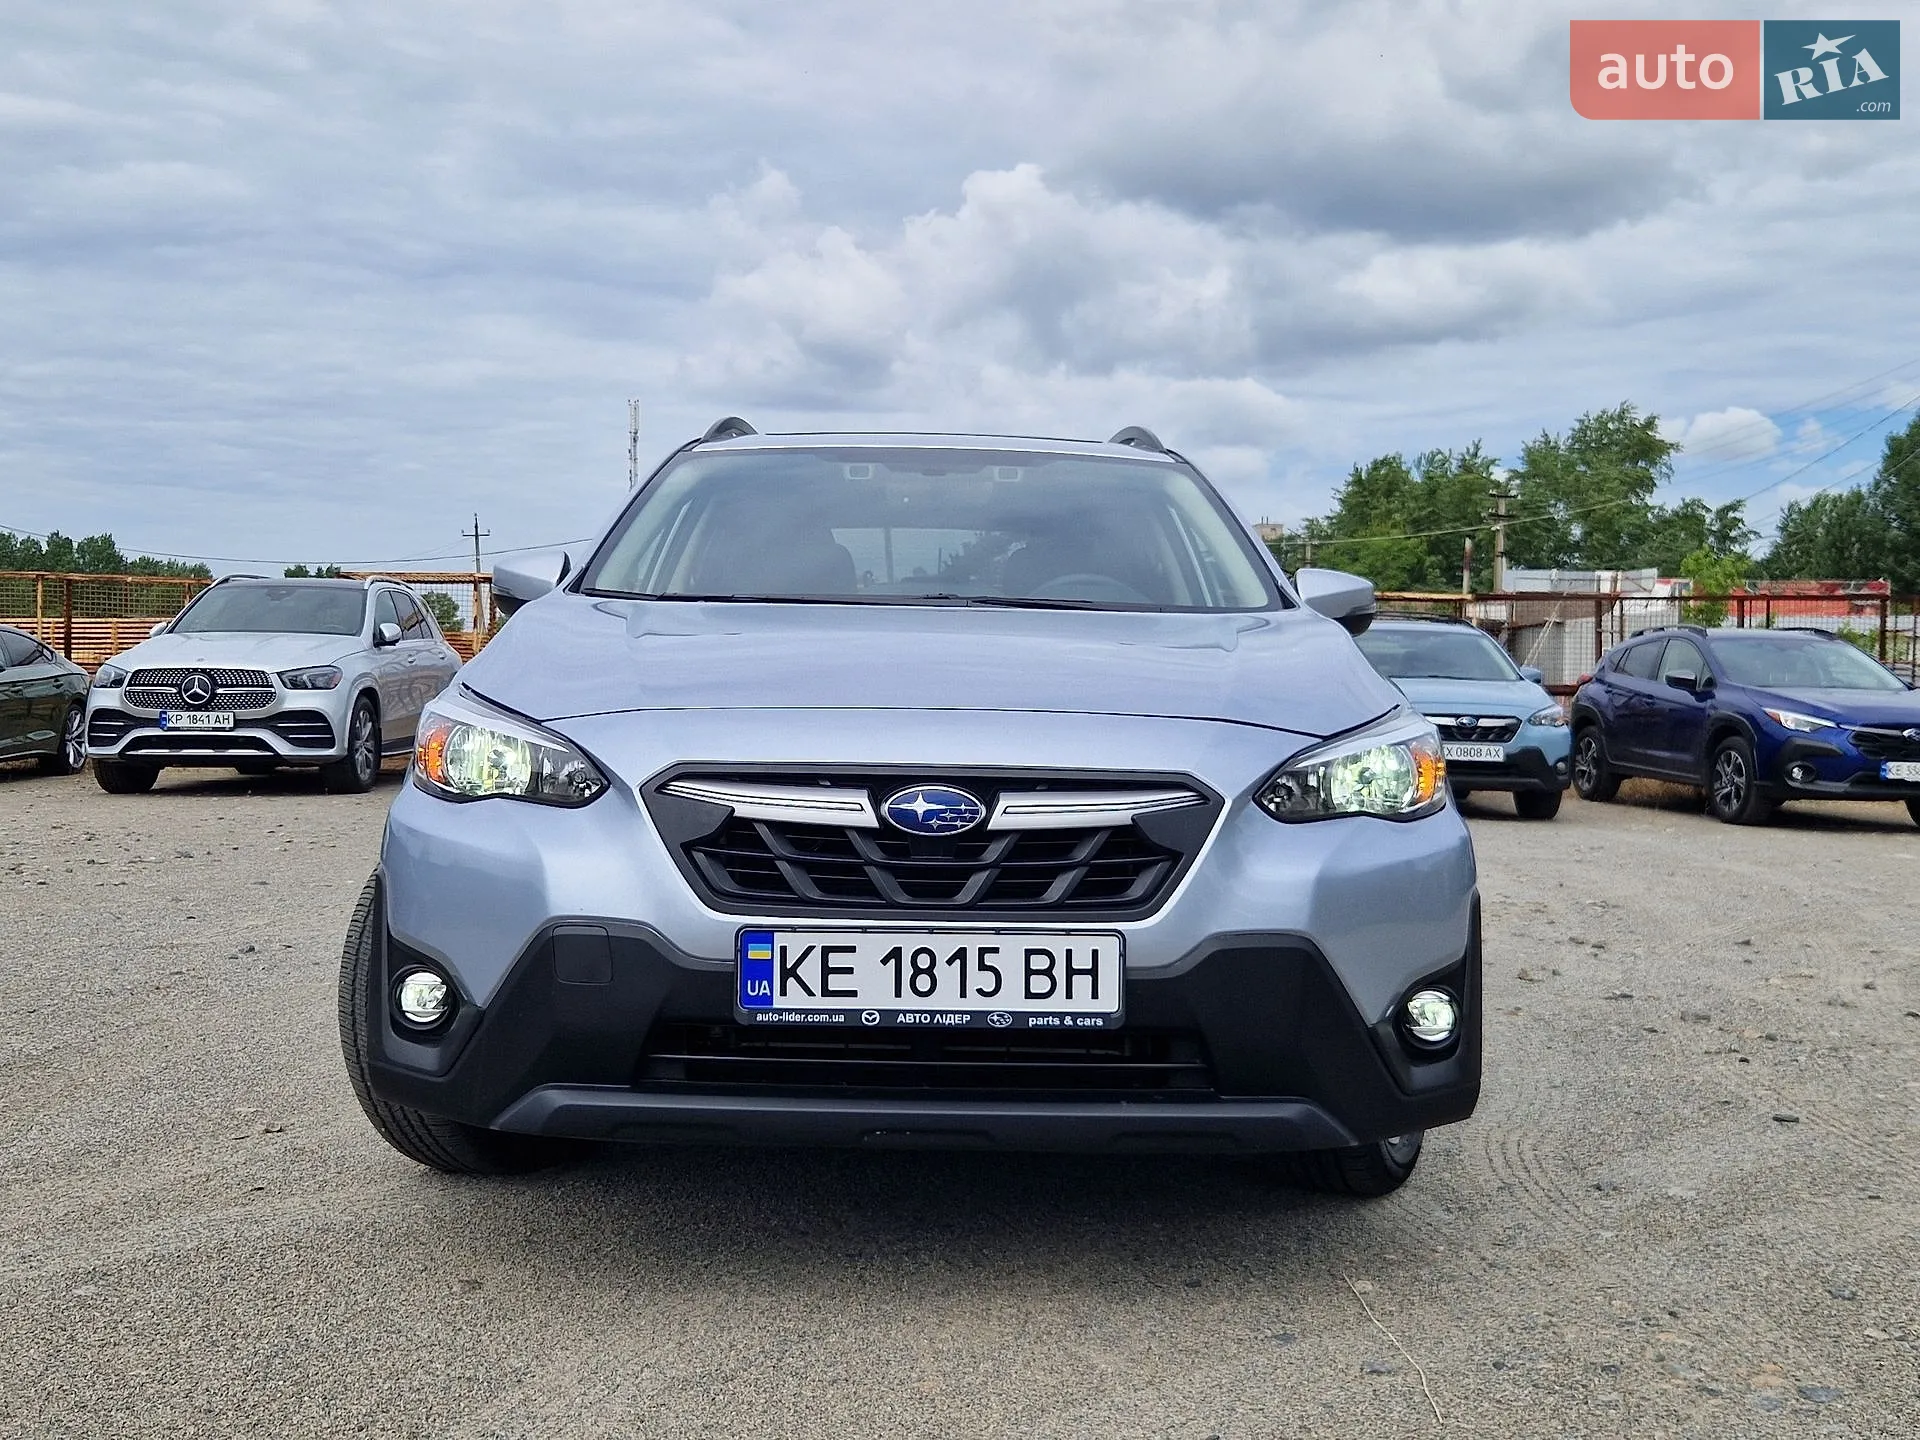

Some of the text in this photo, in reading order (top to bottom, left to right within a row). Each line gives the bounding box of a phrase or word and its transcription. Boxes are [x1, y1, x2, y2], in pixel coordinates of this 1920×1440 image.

[167, 714, 231, 725] KP 1841 AH
[1455, 746, 1483, 758] 0808
[1484, 747, 1501, 759] AX
[778, 945, 1100, 1001] KE 1815 BH
[746, 980, 772, 997] UA
[755, 1011, 845, 1023] auto-lider.com.ua
[896, 1013, 929, 1024] АВТО
[1028, 1015, 1104, 1027] parts & cars
